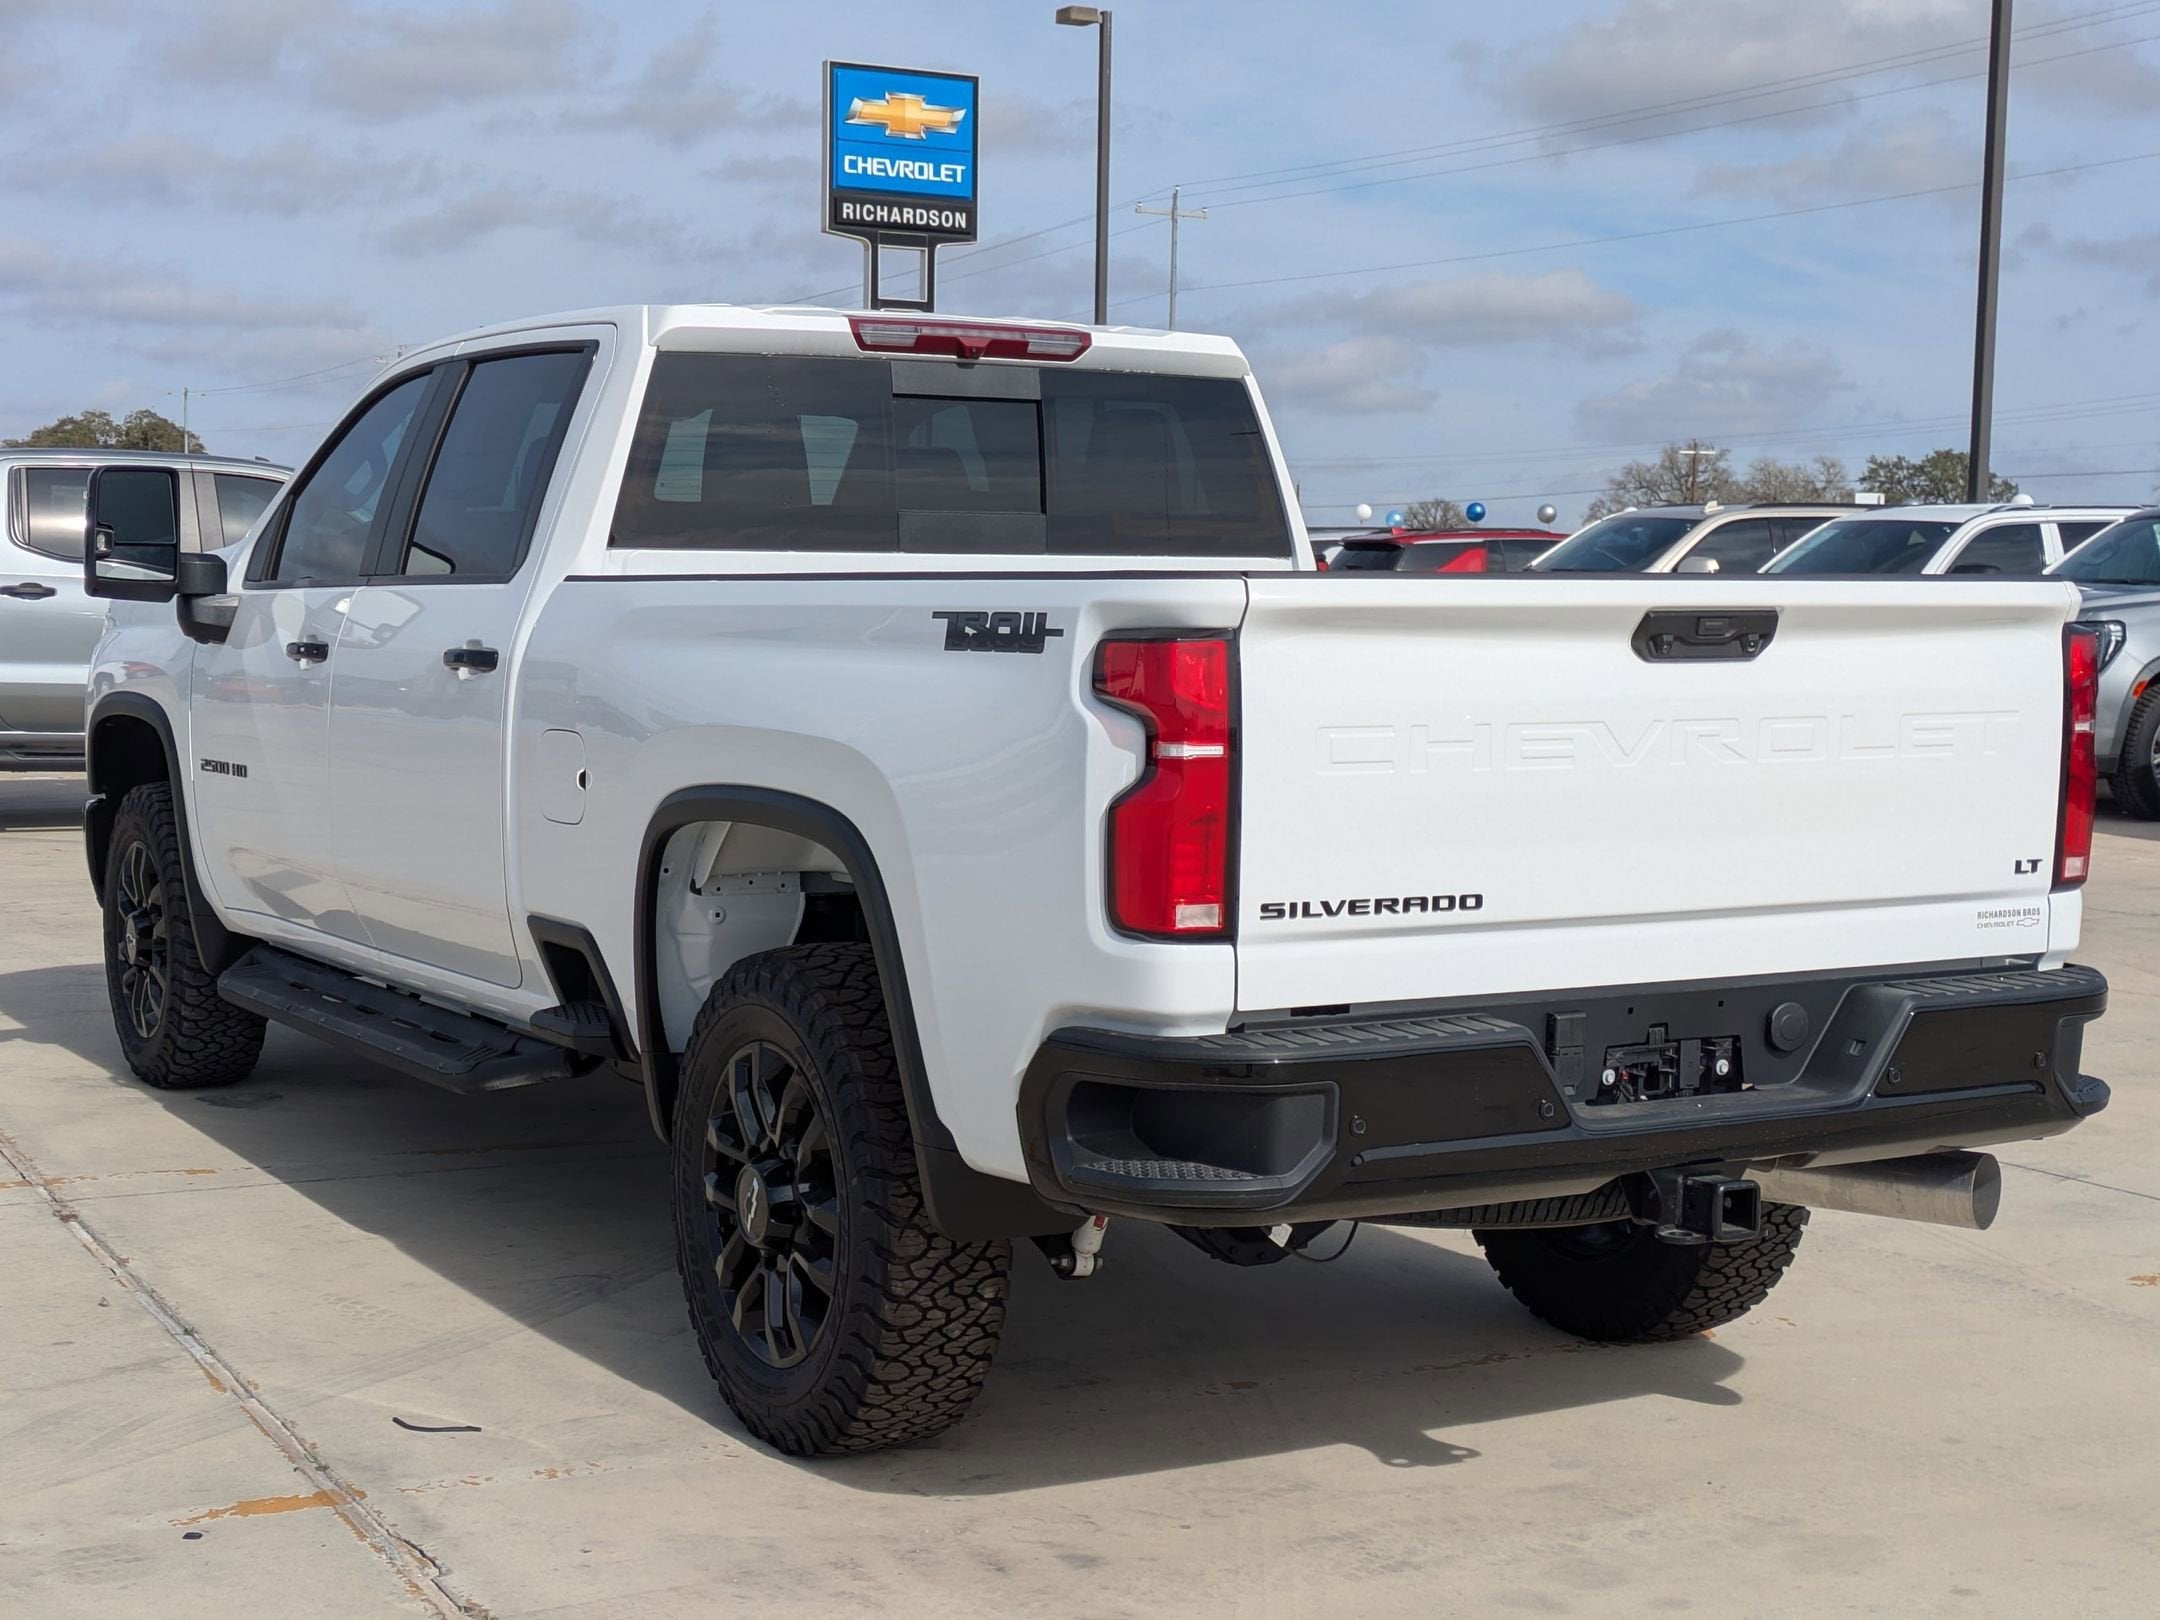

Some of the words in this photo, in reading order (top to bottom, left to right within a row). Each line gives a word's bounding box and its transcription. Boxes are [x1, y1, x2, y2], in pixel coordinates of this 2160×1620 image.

[843, 155, 966, 183] CHEVROLET
[842, 202, 967, 229] RICHARDSON
[1314, 709, 2021, 775] CHEVROLET
[200, 758, 230, 775] 2500
[2014, 859, 2043, 874] LT
[1260, 894, 1483, 920] SILVERADO
[1977, 908, 2021, 920] RICHARDSON
[2022, 907, 2040, 917] BROS
[1977, 920, 2014, 929] CHEVROLET
